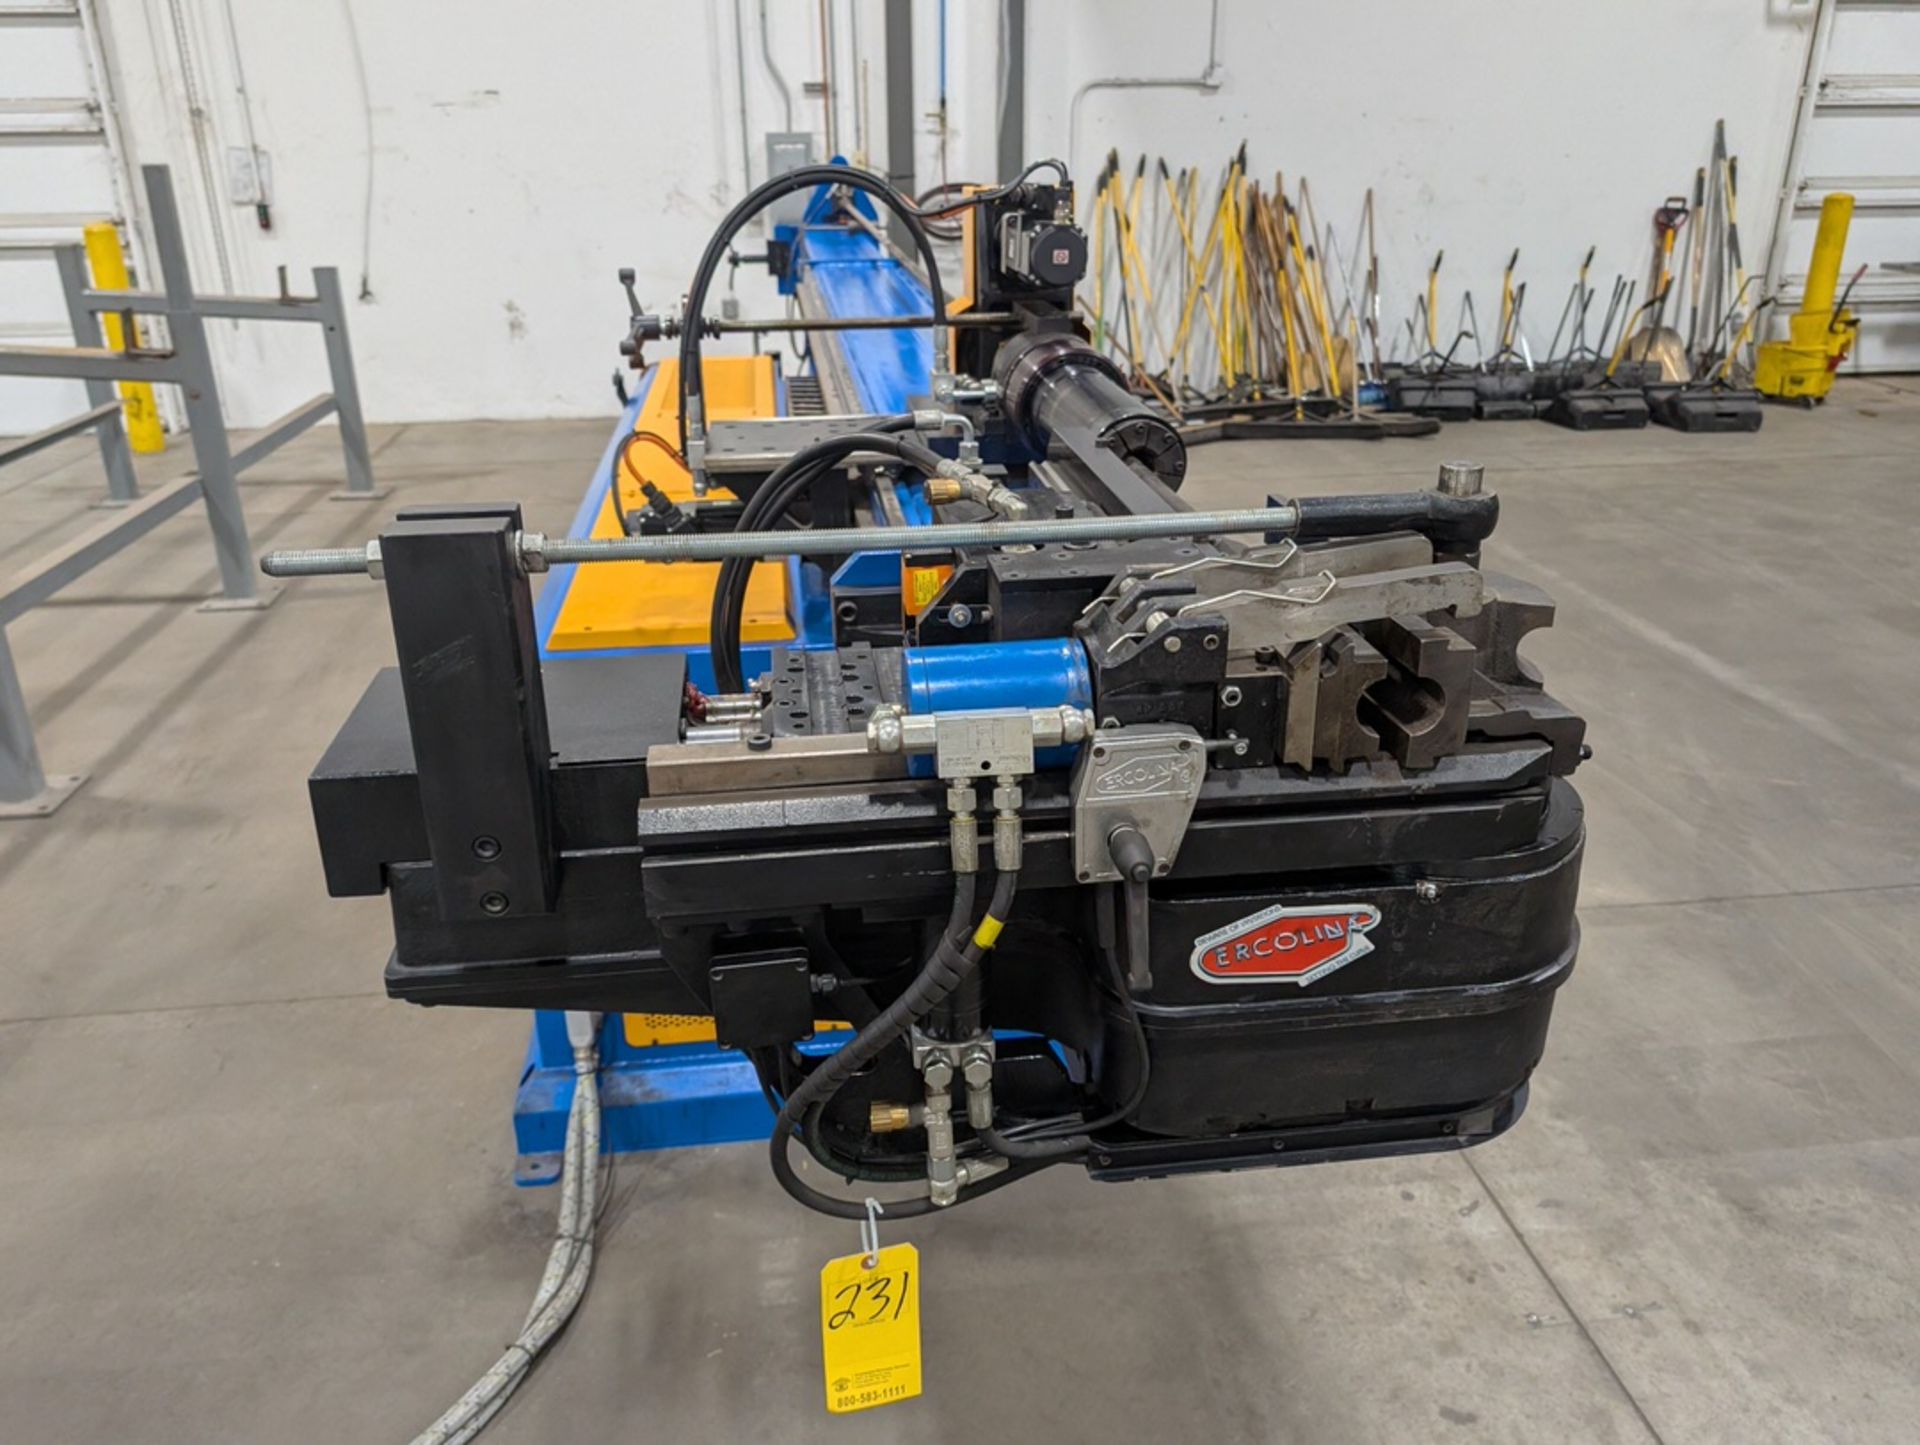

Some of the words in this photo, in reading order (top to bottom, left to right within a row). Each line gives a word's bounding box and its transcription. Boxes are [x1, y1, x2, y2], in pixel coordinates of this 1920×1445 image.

[1215, 912, 1363, 967] ERCOLINA
[828, 1271, 909, 1330] 231
[836, 1383, 907, 1409] 800-583-1111
